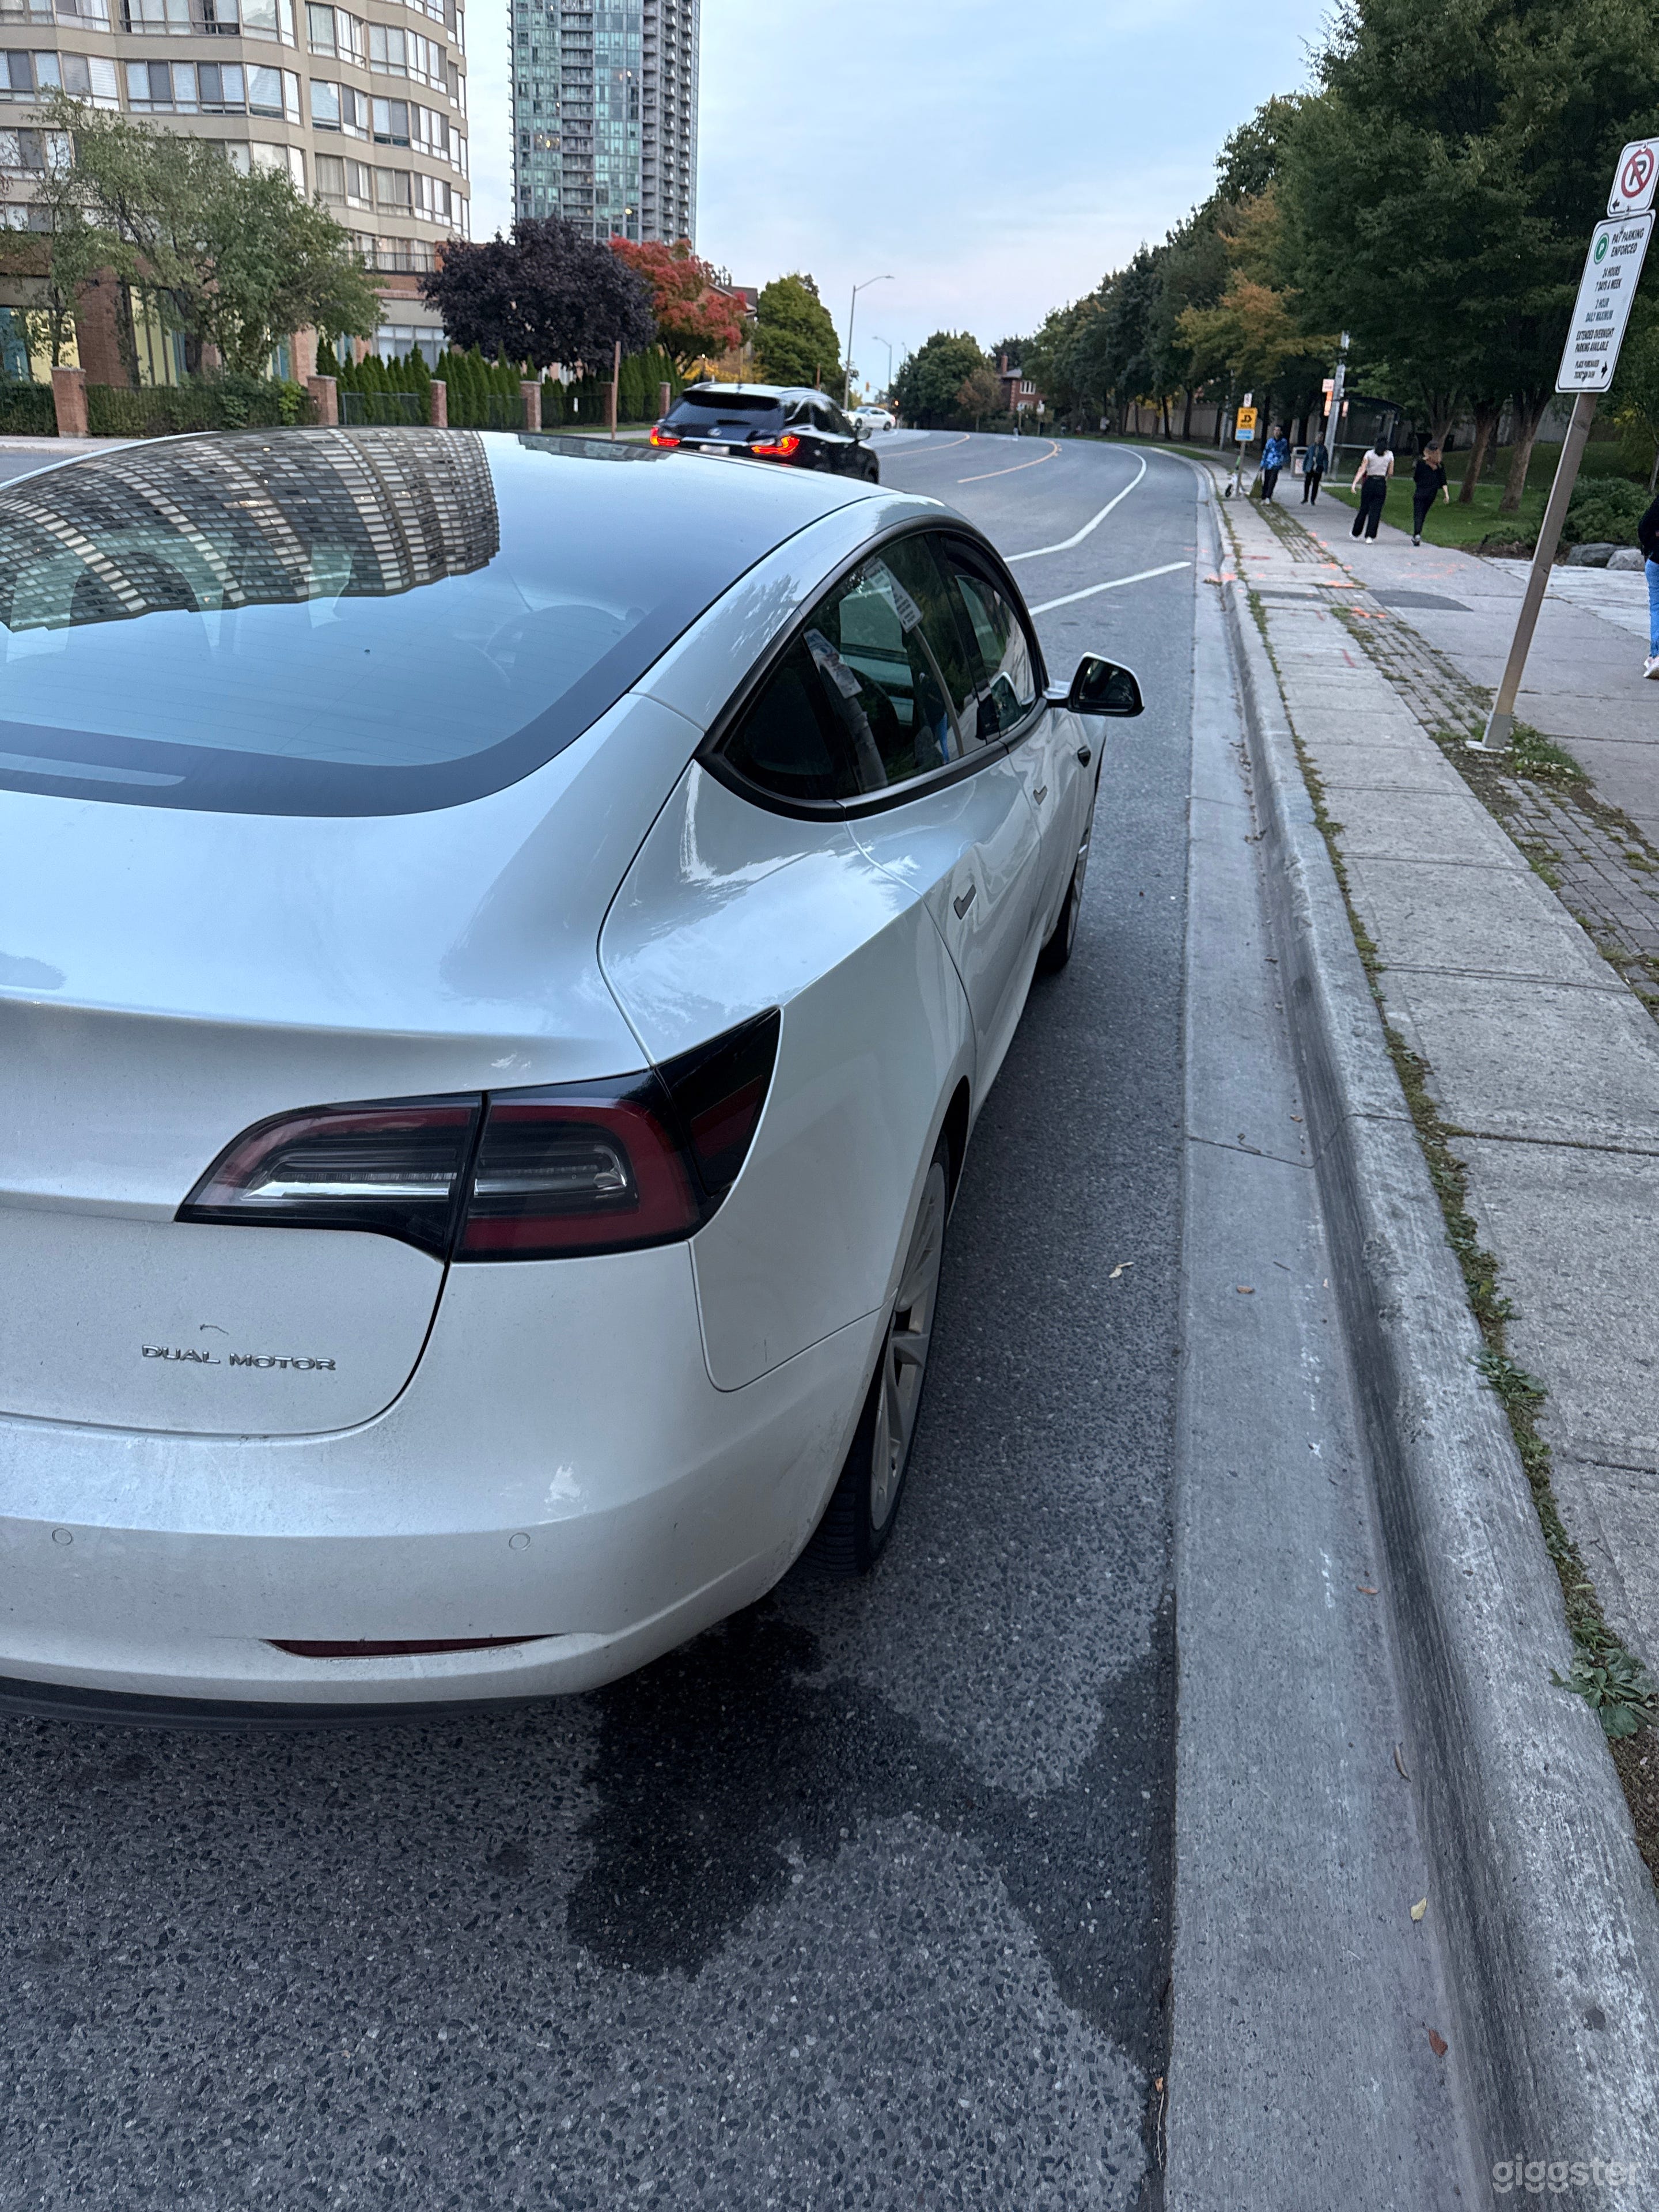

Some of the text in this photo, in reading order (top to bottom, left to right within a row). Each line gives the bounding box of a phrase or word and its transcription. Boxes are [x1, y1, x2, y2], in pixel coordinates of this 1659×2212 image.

[1612, 228, 1645, 244] PAY PARKING
[1599, 243, 1605, 255] P
[1611, 243, 1638, 257] ENFORCED
[1603, 266, 1621, 278] 24 HOURS
[1598, 281, 1608, 291] DAYS
[1611, 279, 1623, 289] WEEK
[1599, 298, 1609, 308] HOUR
[1586, 310, 1613, 322] DAILY MAXIMUM
[1577, 328, 1615, 340] EXTENDED OVERNIGHT
[1575, 341, 1609, 352] PARKING AVAILABLE
[142, 1344, 336, 1370] DUAL MOTOR
